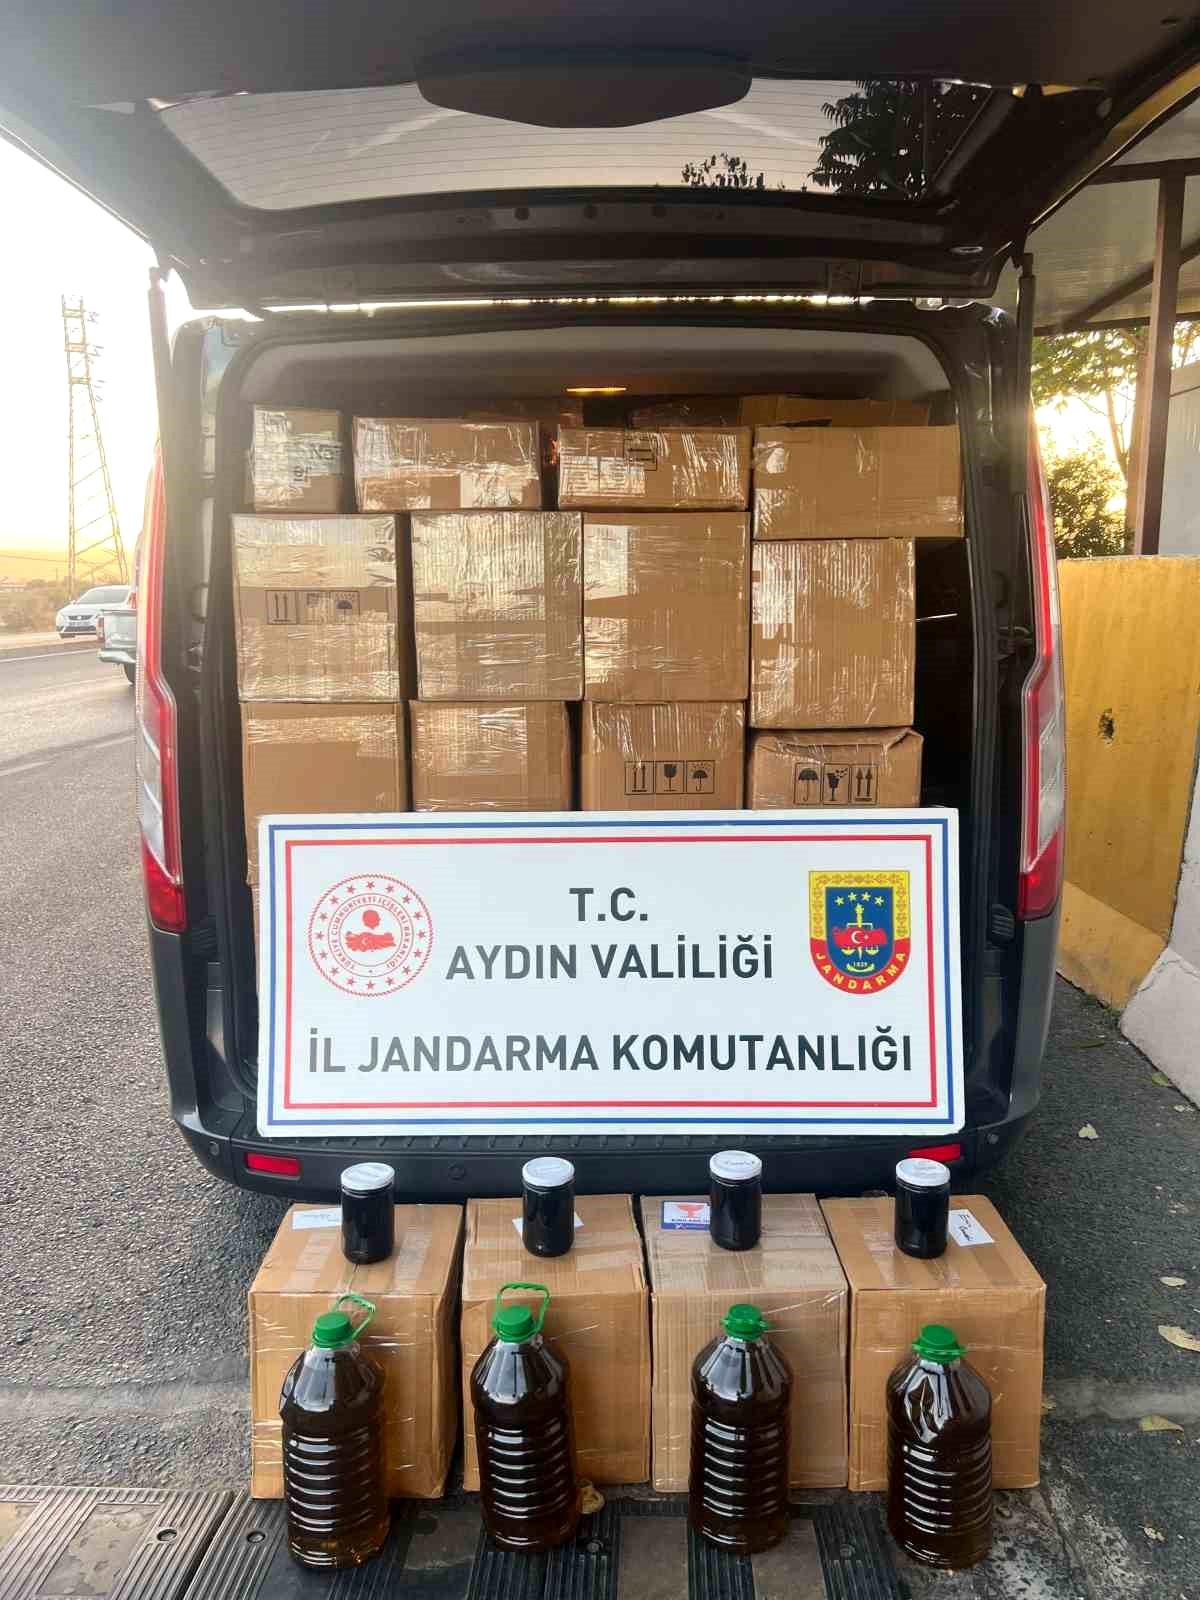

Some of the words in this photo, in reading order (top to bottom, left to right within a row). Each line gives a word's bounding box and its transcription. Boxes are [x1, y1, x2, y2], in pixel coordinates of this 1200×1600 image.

[569, 887, 648, 922] T.C.
[446, 944, 577, 980] AYDIN
[591, 934, 773, 979] VALİLİĞİ
[816, 952, 906, 990] JANDARMA
[309, 1027, 346, 1073] İL
[357, 1034, 600, 1073] JANDARMA
[612, 1025, 912, 1072] KOMUTANLIĞI
